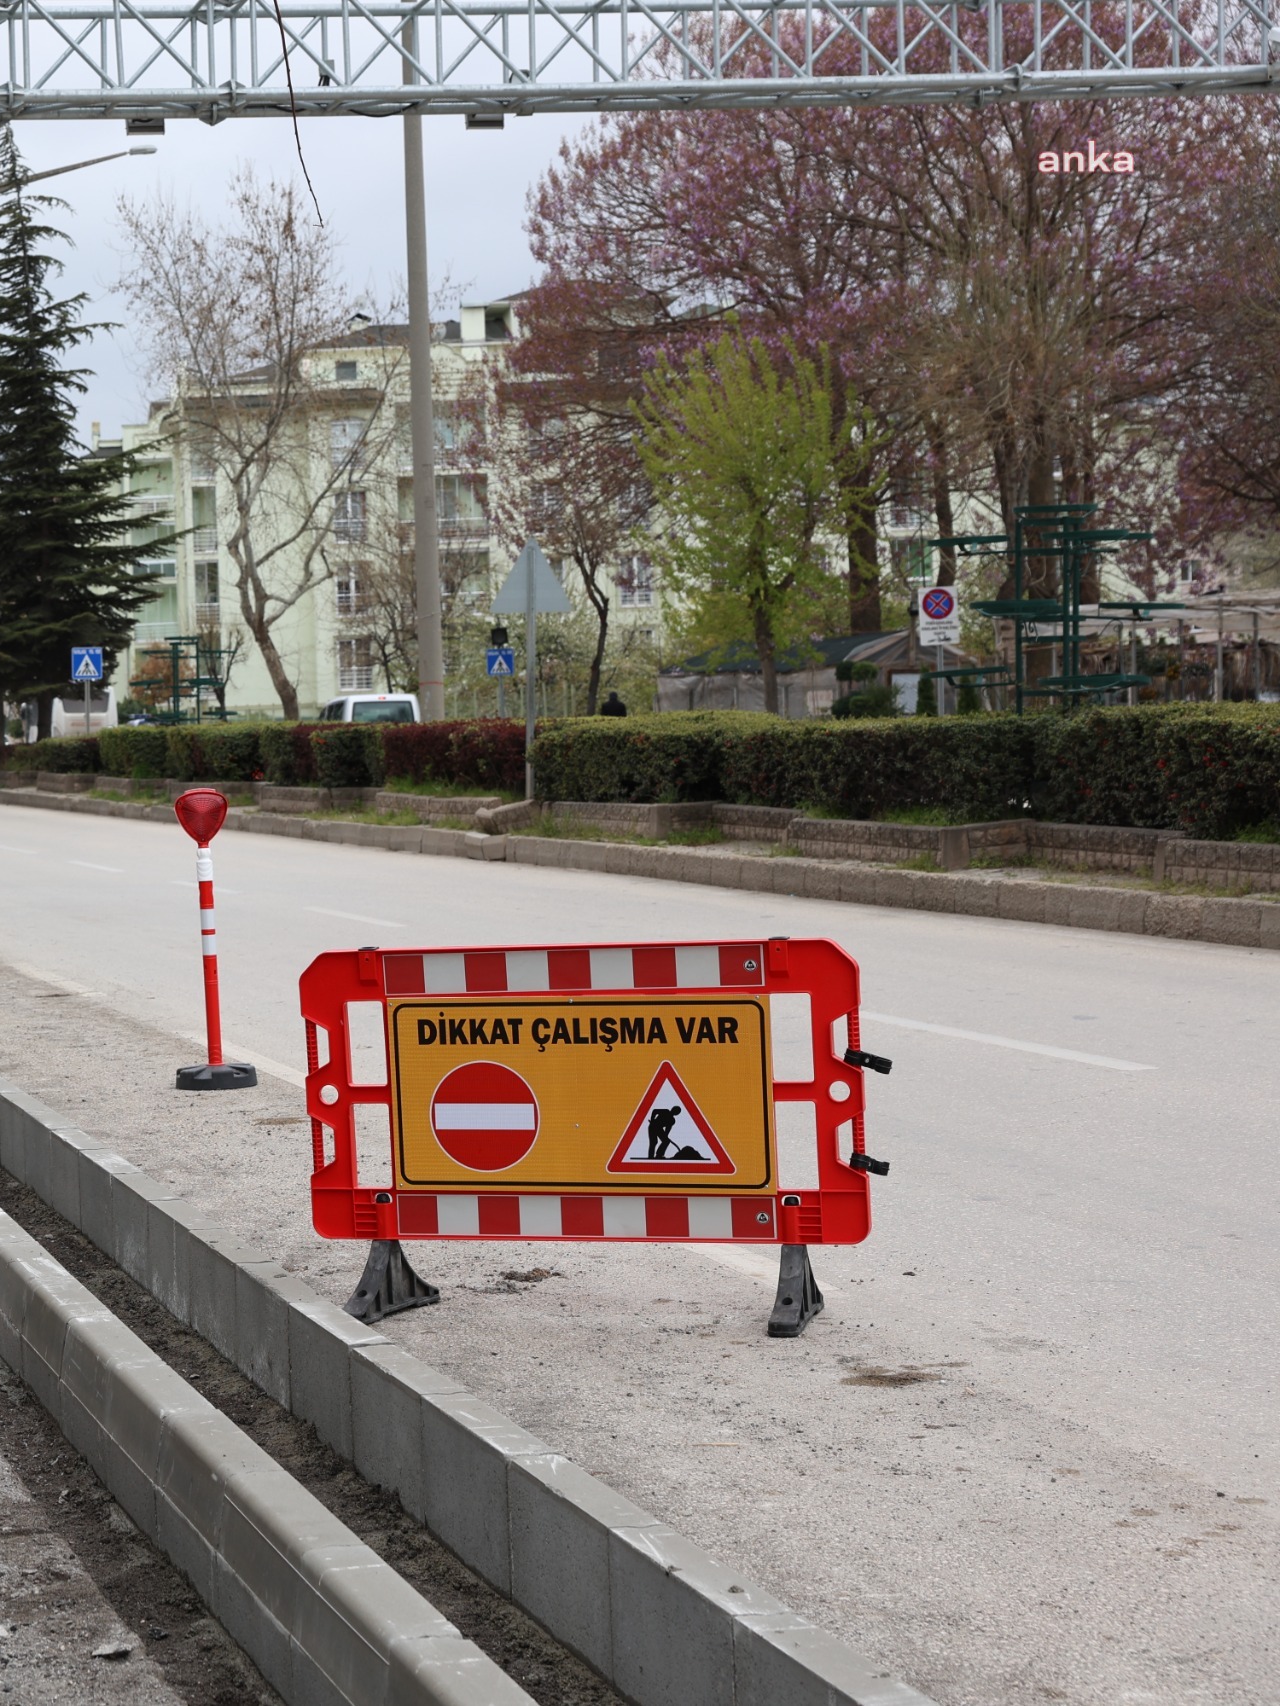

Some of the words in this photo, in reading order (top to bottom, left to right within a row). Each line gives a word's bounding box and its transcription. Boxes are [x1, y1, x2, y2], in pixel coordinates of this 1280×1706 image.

[417, 1011, 523, 1045] DİKKAT
[531, 1017, 668, 1052] ÇALIŞMA
[675, 1017, 739, 1044] VAR
